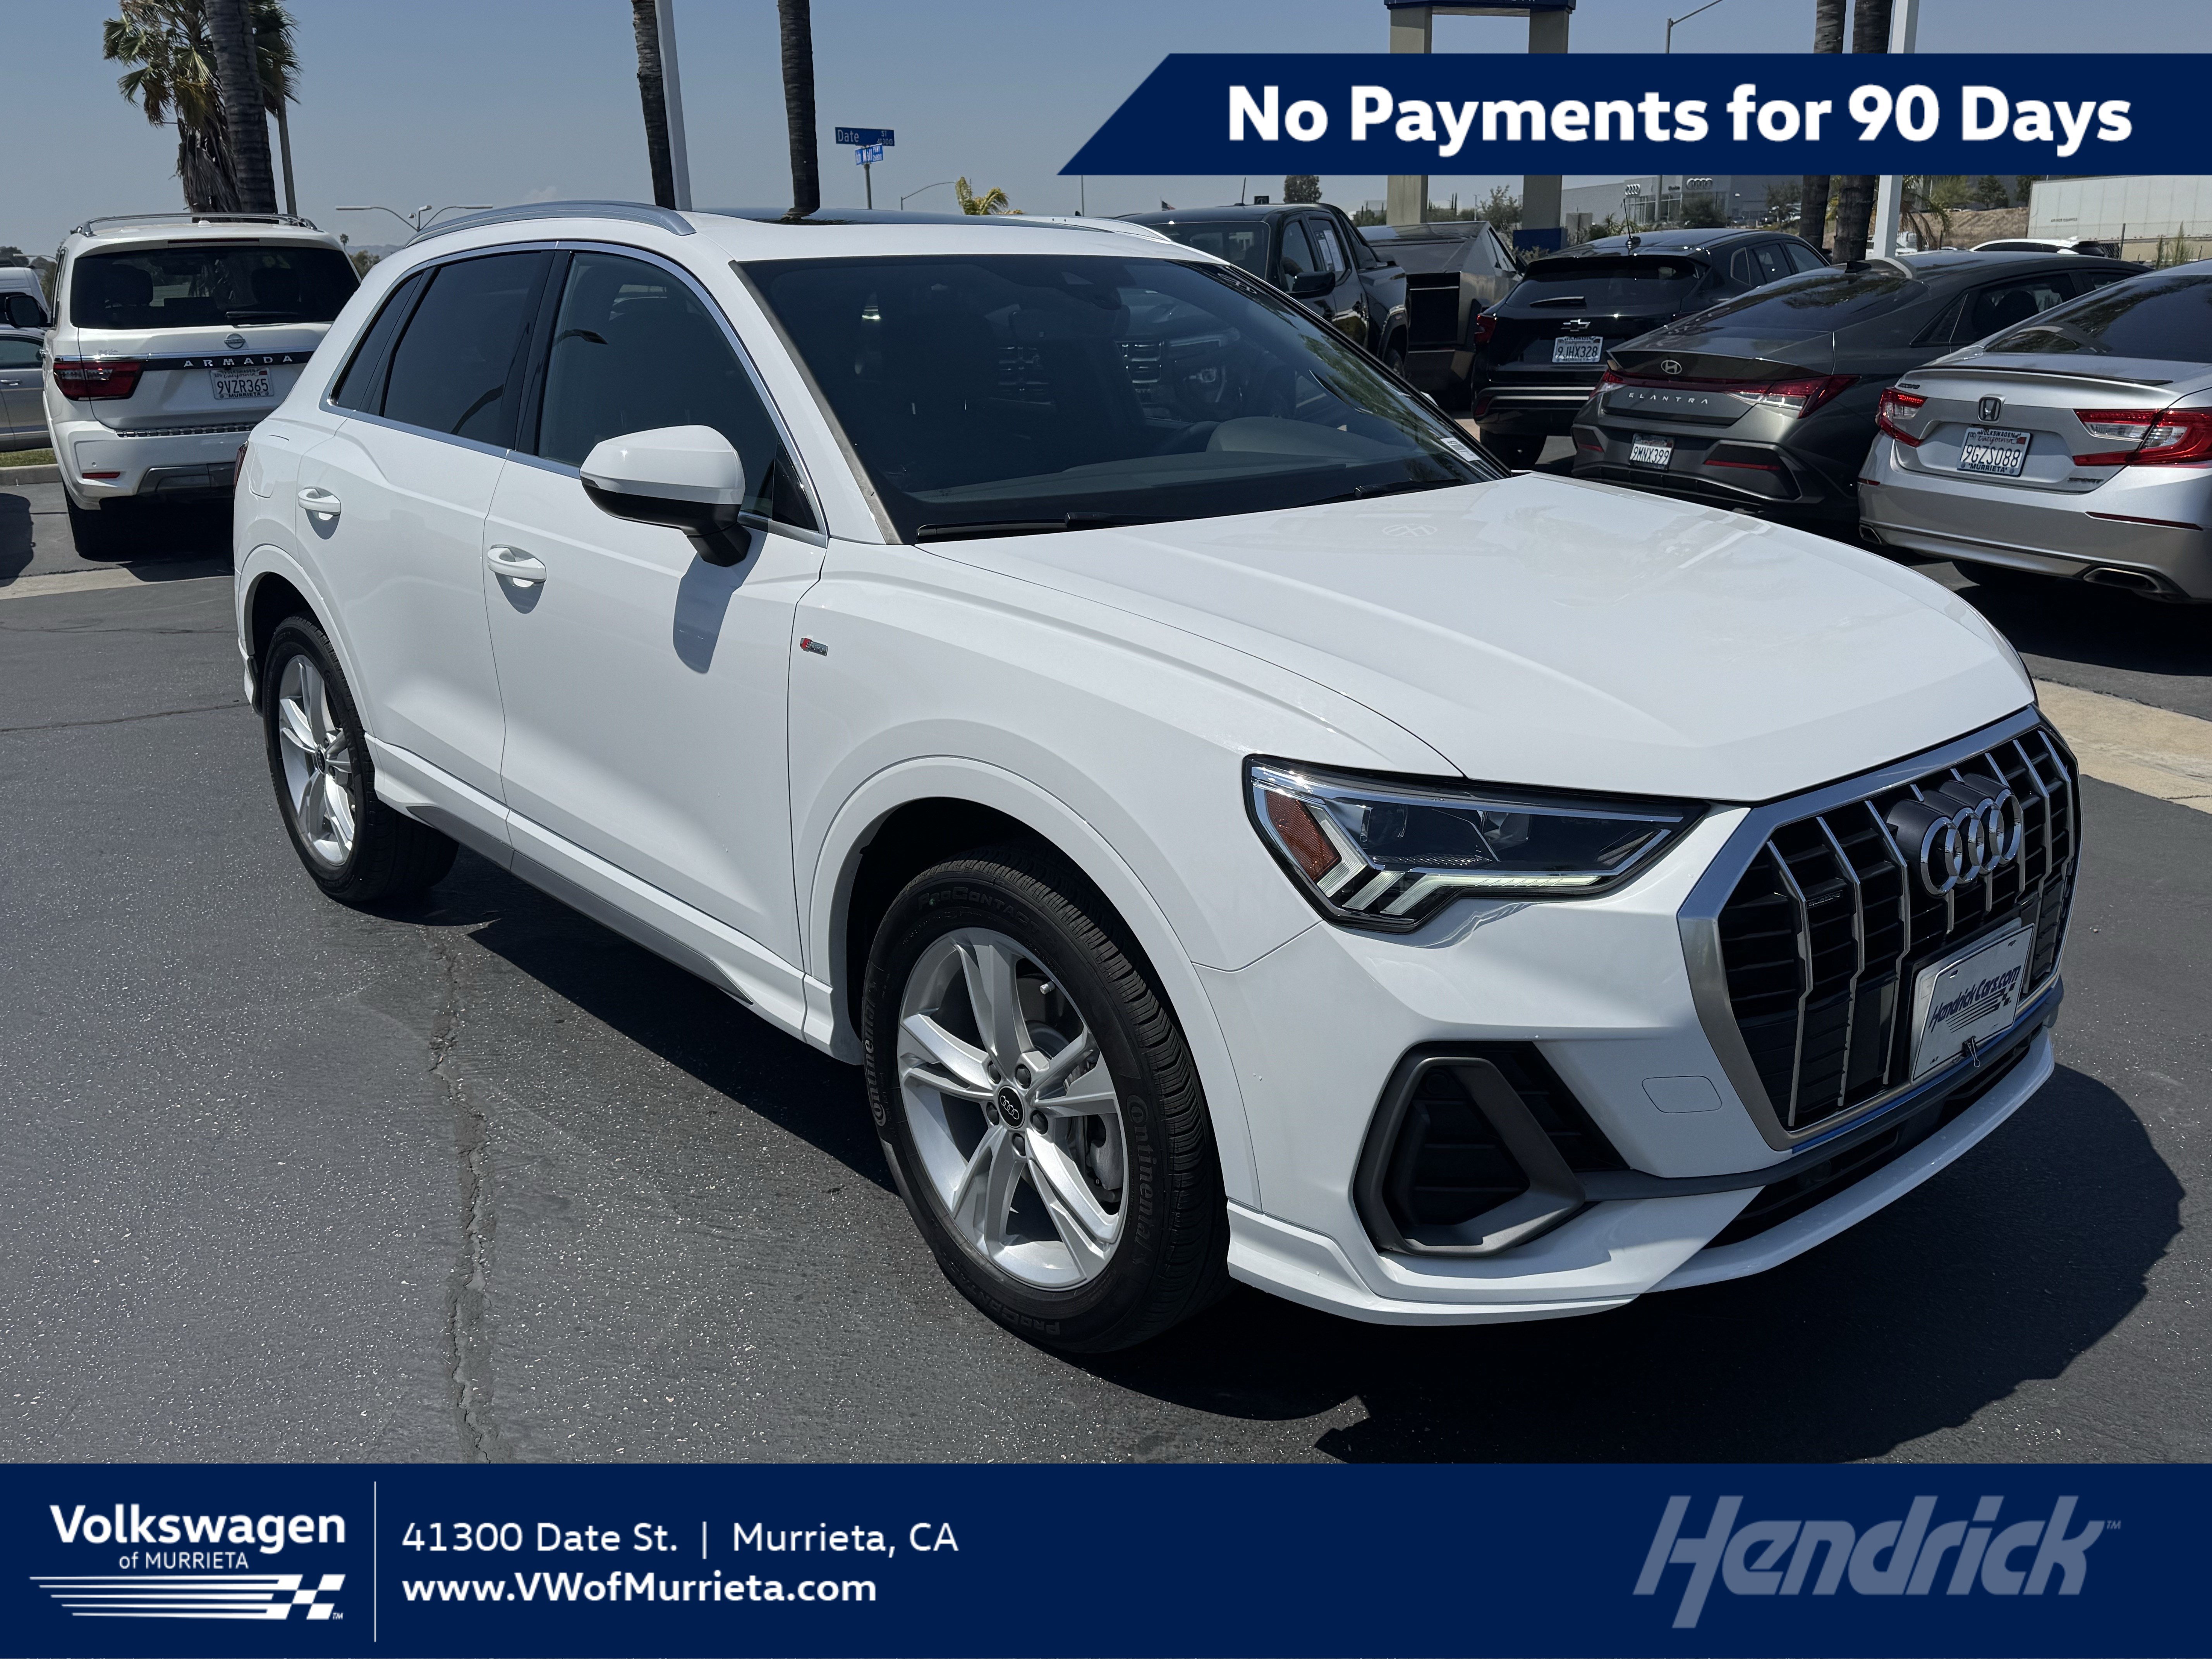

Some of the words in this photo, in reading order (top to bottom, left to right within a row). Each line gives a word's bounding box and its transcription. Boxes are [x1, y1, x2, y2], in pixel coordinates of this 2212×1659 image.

[837, 129, 859, 143] Date
[1558, 346, 1598, 358] 9JHX328
[183, 355, 293, 368] ARMADA
[217, 378, 269, 394] 9VZR365
[1628, 392, 1708, 404] ELANTRA
[1632, 446, 1669, 464] 9MNX399
[1962, 444, 2021, 467] 9GZS088
[1126, 1093, 1158, 1252] Continental
